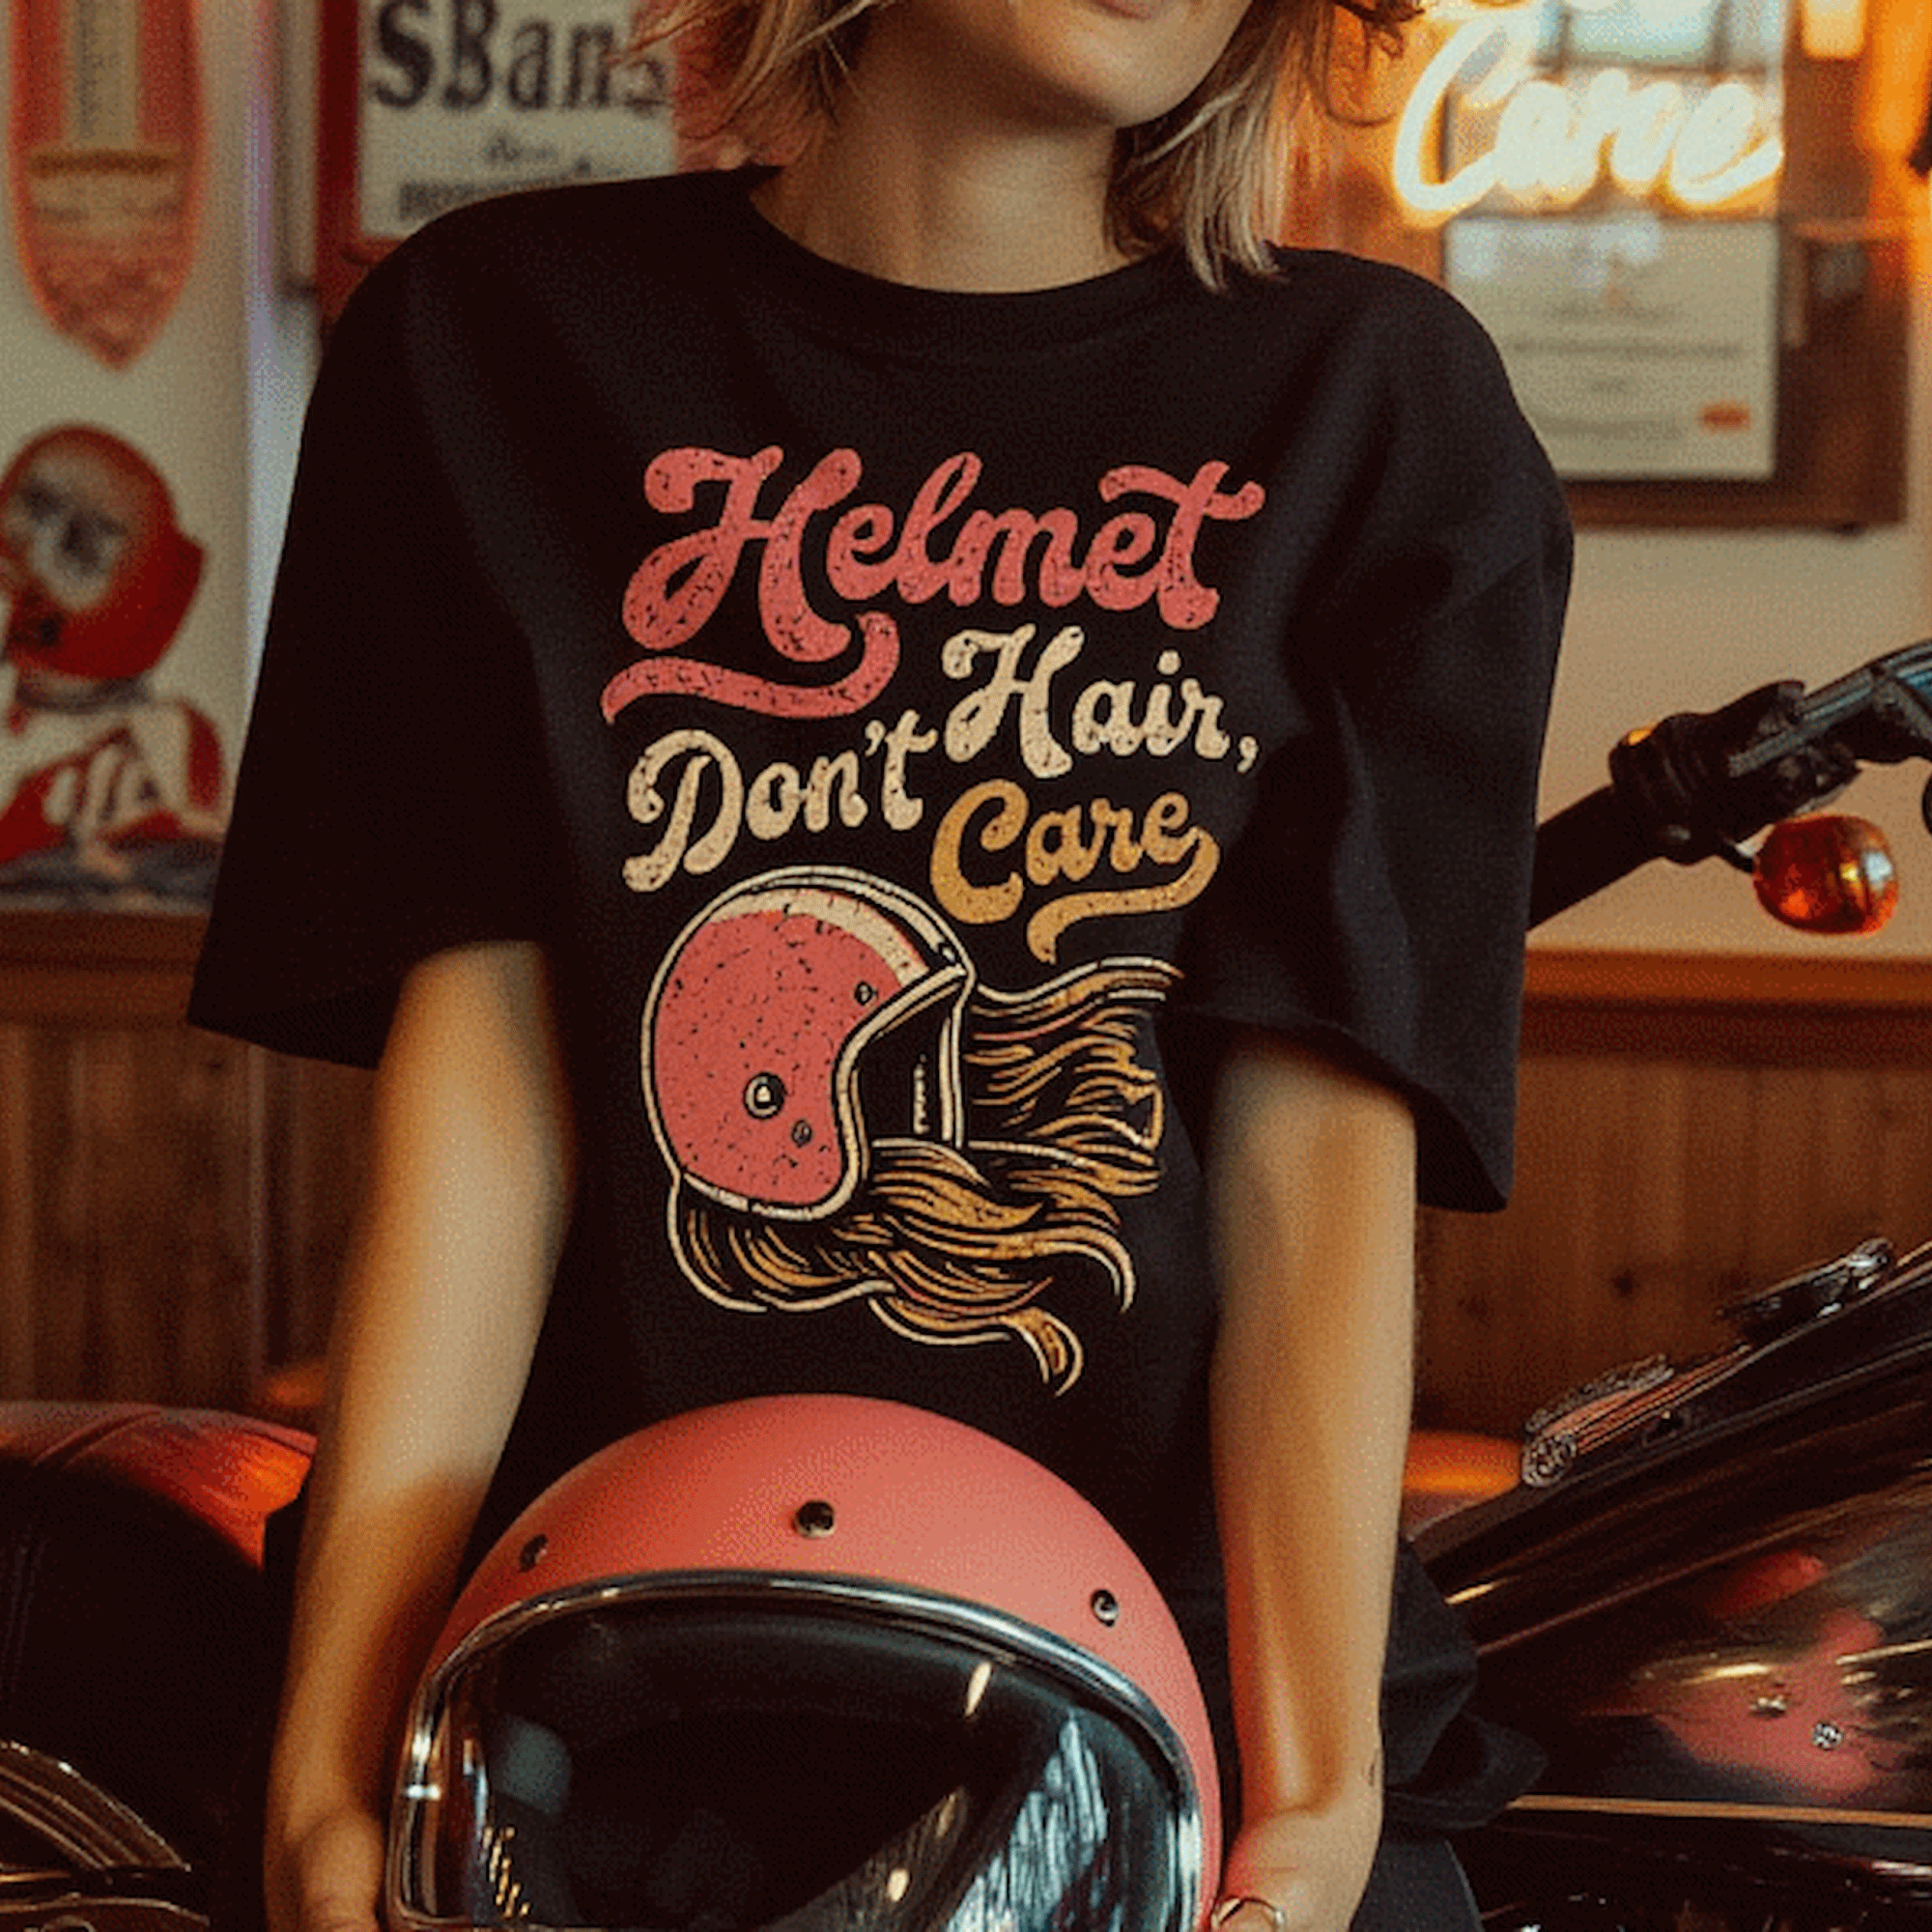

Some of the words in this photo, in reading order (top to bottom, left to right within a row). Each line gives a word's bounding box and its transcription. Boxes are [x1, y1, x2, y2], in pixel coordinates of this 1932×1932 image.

[601, 444, 1266, 724] Helmet
[940, 623, 1260, 779] Hair,
[622, 710, 939, 894] Don't
[929, 779, 1221, 964] Care
